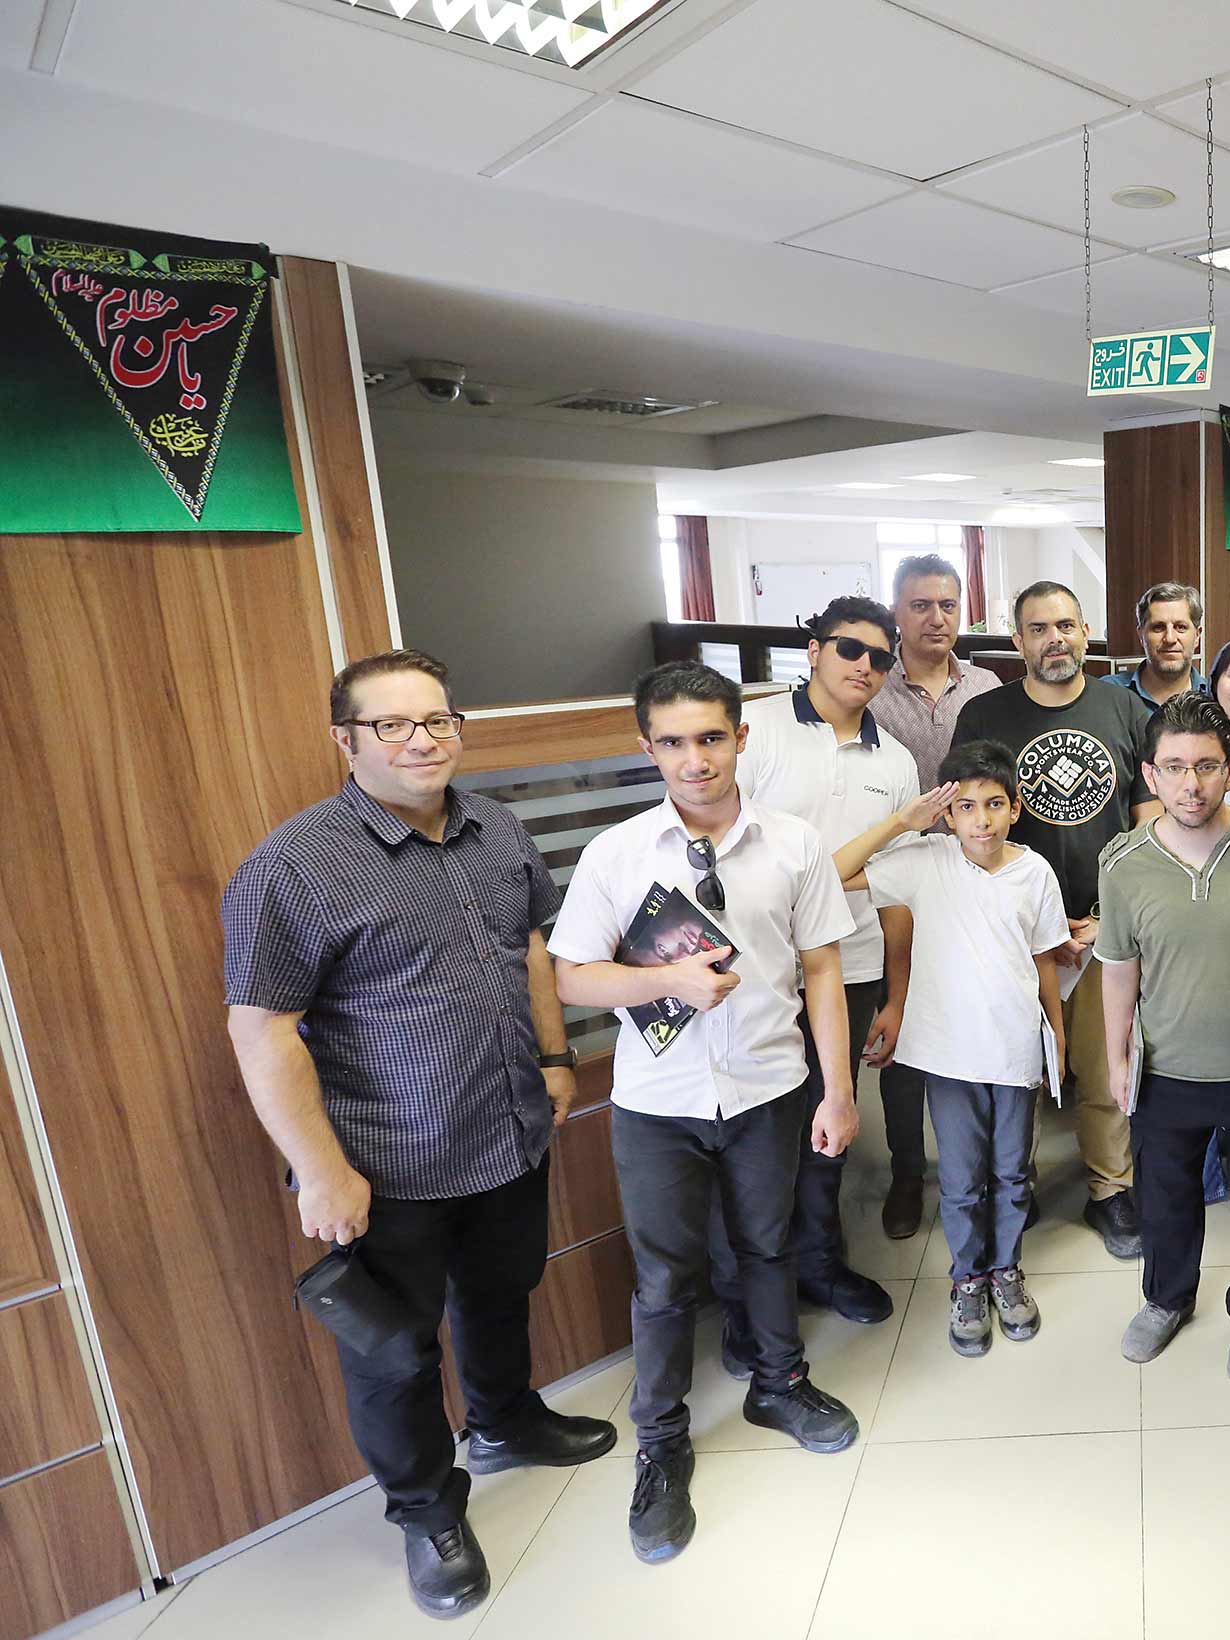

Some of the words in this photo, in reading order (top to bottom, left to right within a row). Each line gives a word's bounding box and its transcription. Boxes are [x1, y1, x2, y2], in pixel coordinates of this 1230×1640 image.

[96, 287, 179, 347] مظلوم
[110, 304, 238, 388] حسین
[1094, 343, 1126, 366] خروج
[178, 342, 207, 410] یا
[1092, 368, 1125, 388] EXIT
[1019, 734, 1110, 780] COLUMBIA
[1034, 747, 1083, 774] SPORTSWEAR
[1083, 755, 1094, 769] CO.
[1025, 793, 1065, 820] ALWAYS
[1068, 785, 1109, 820] OUTSIDE
[1037, 795, 1086, 812] ESTABLISHED
[1048, 794, 1070, 805] TRADE
[1071, 790, 1089, 804] MARK
